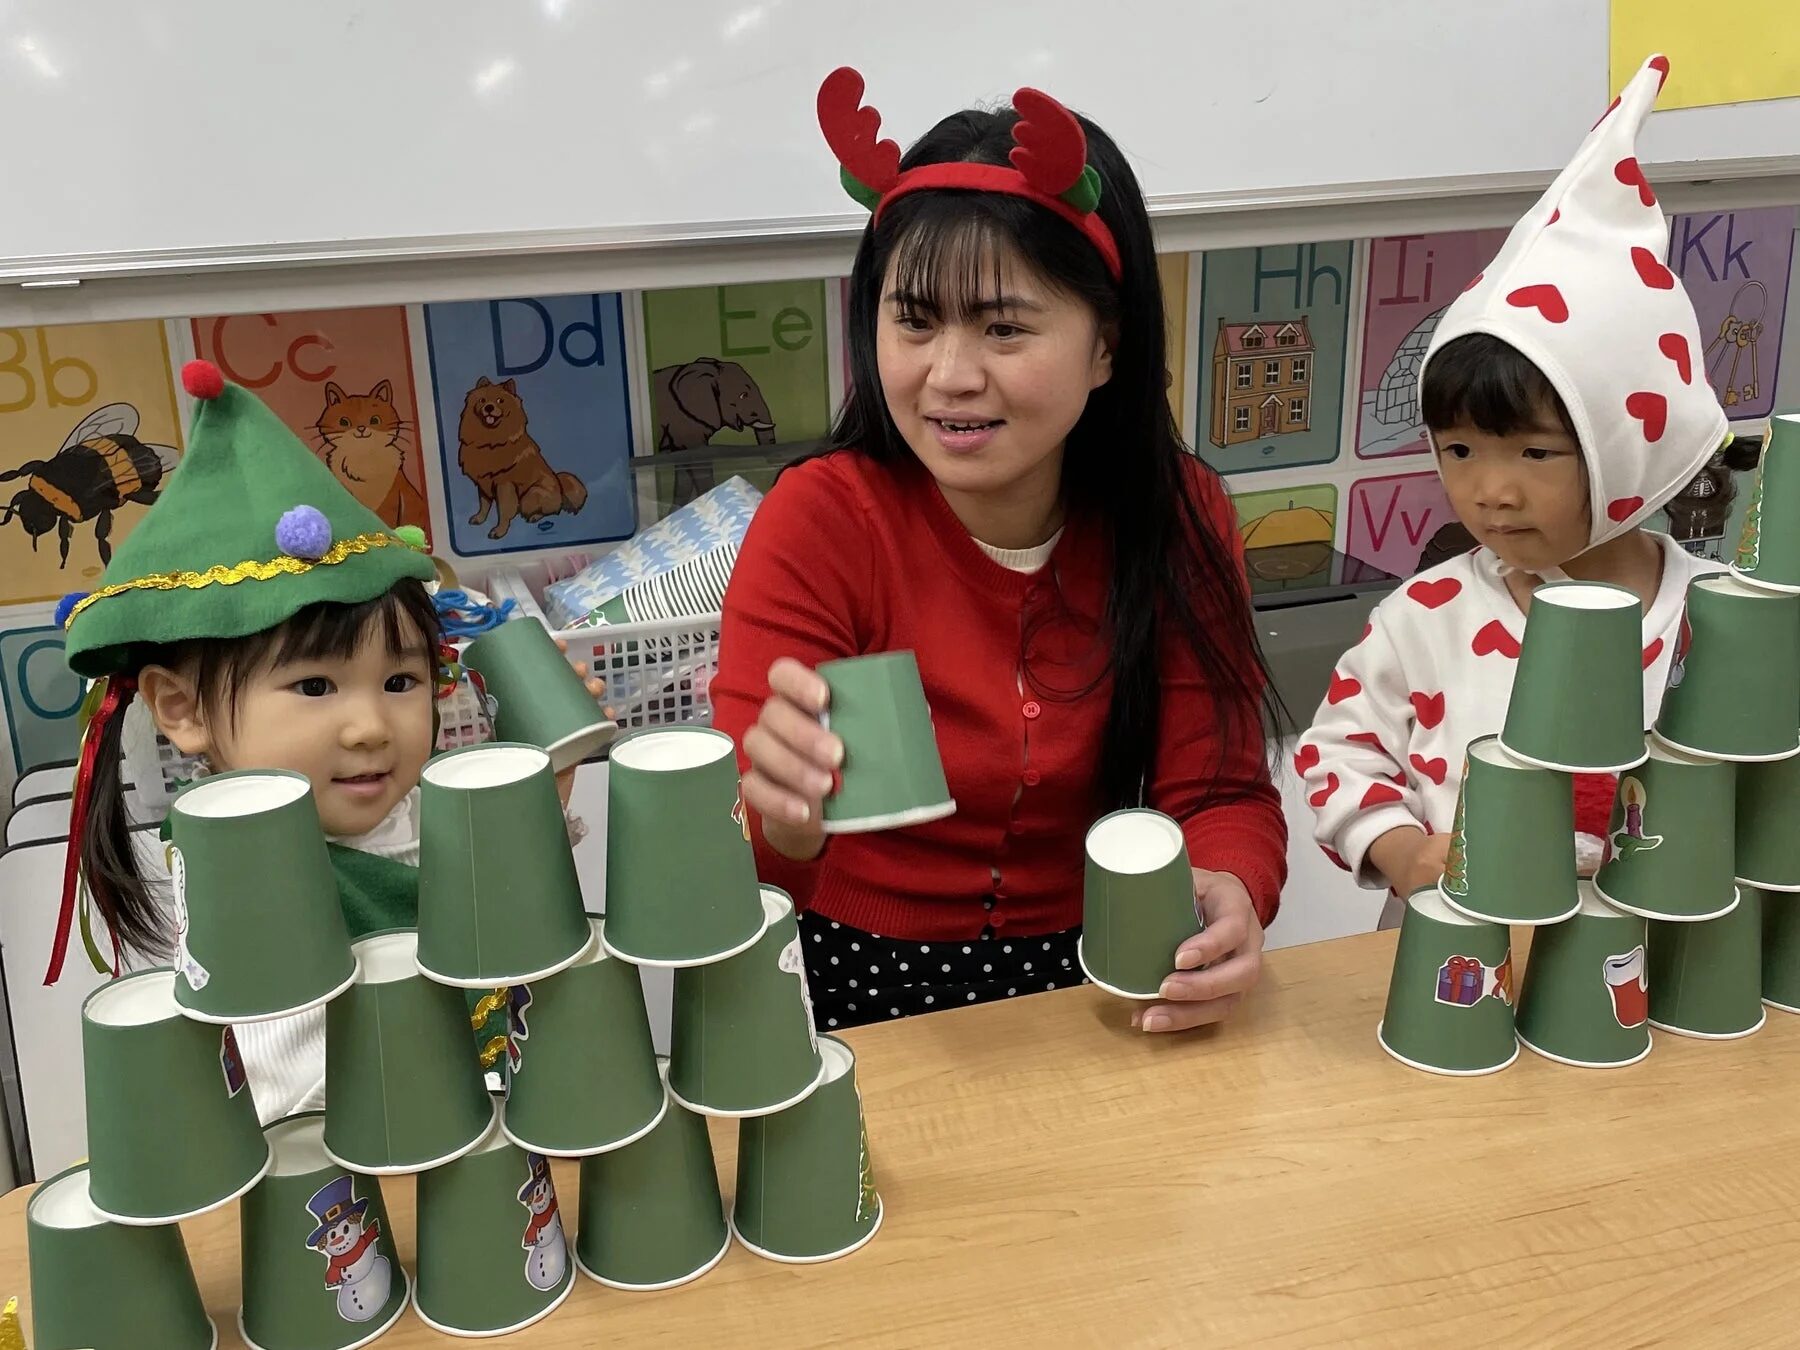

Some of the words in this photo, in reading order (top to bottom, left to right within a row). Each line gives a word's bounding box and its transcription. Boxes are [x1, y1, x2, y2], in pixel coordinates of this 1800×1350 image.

[1253, 242, 1342, 312] Hh
[1378, 235, 1434, 306] Ii
[1679, 214, 1753, 282] Kk
[212, 314, 337, 388] Cc
[489, 294, 605, 376] Dd
[717, 285, 813, 357] Ee
[0, 327, 98, 412] Bb
[1359, 484, 1432, 552] Vv
